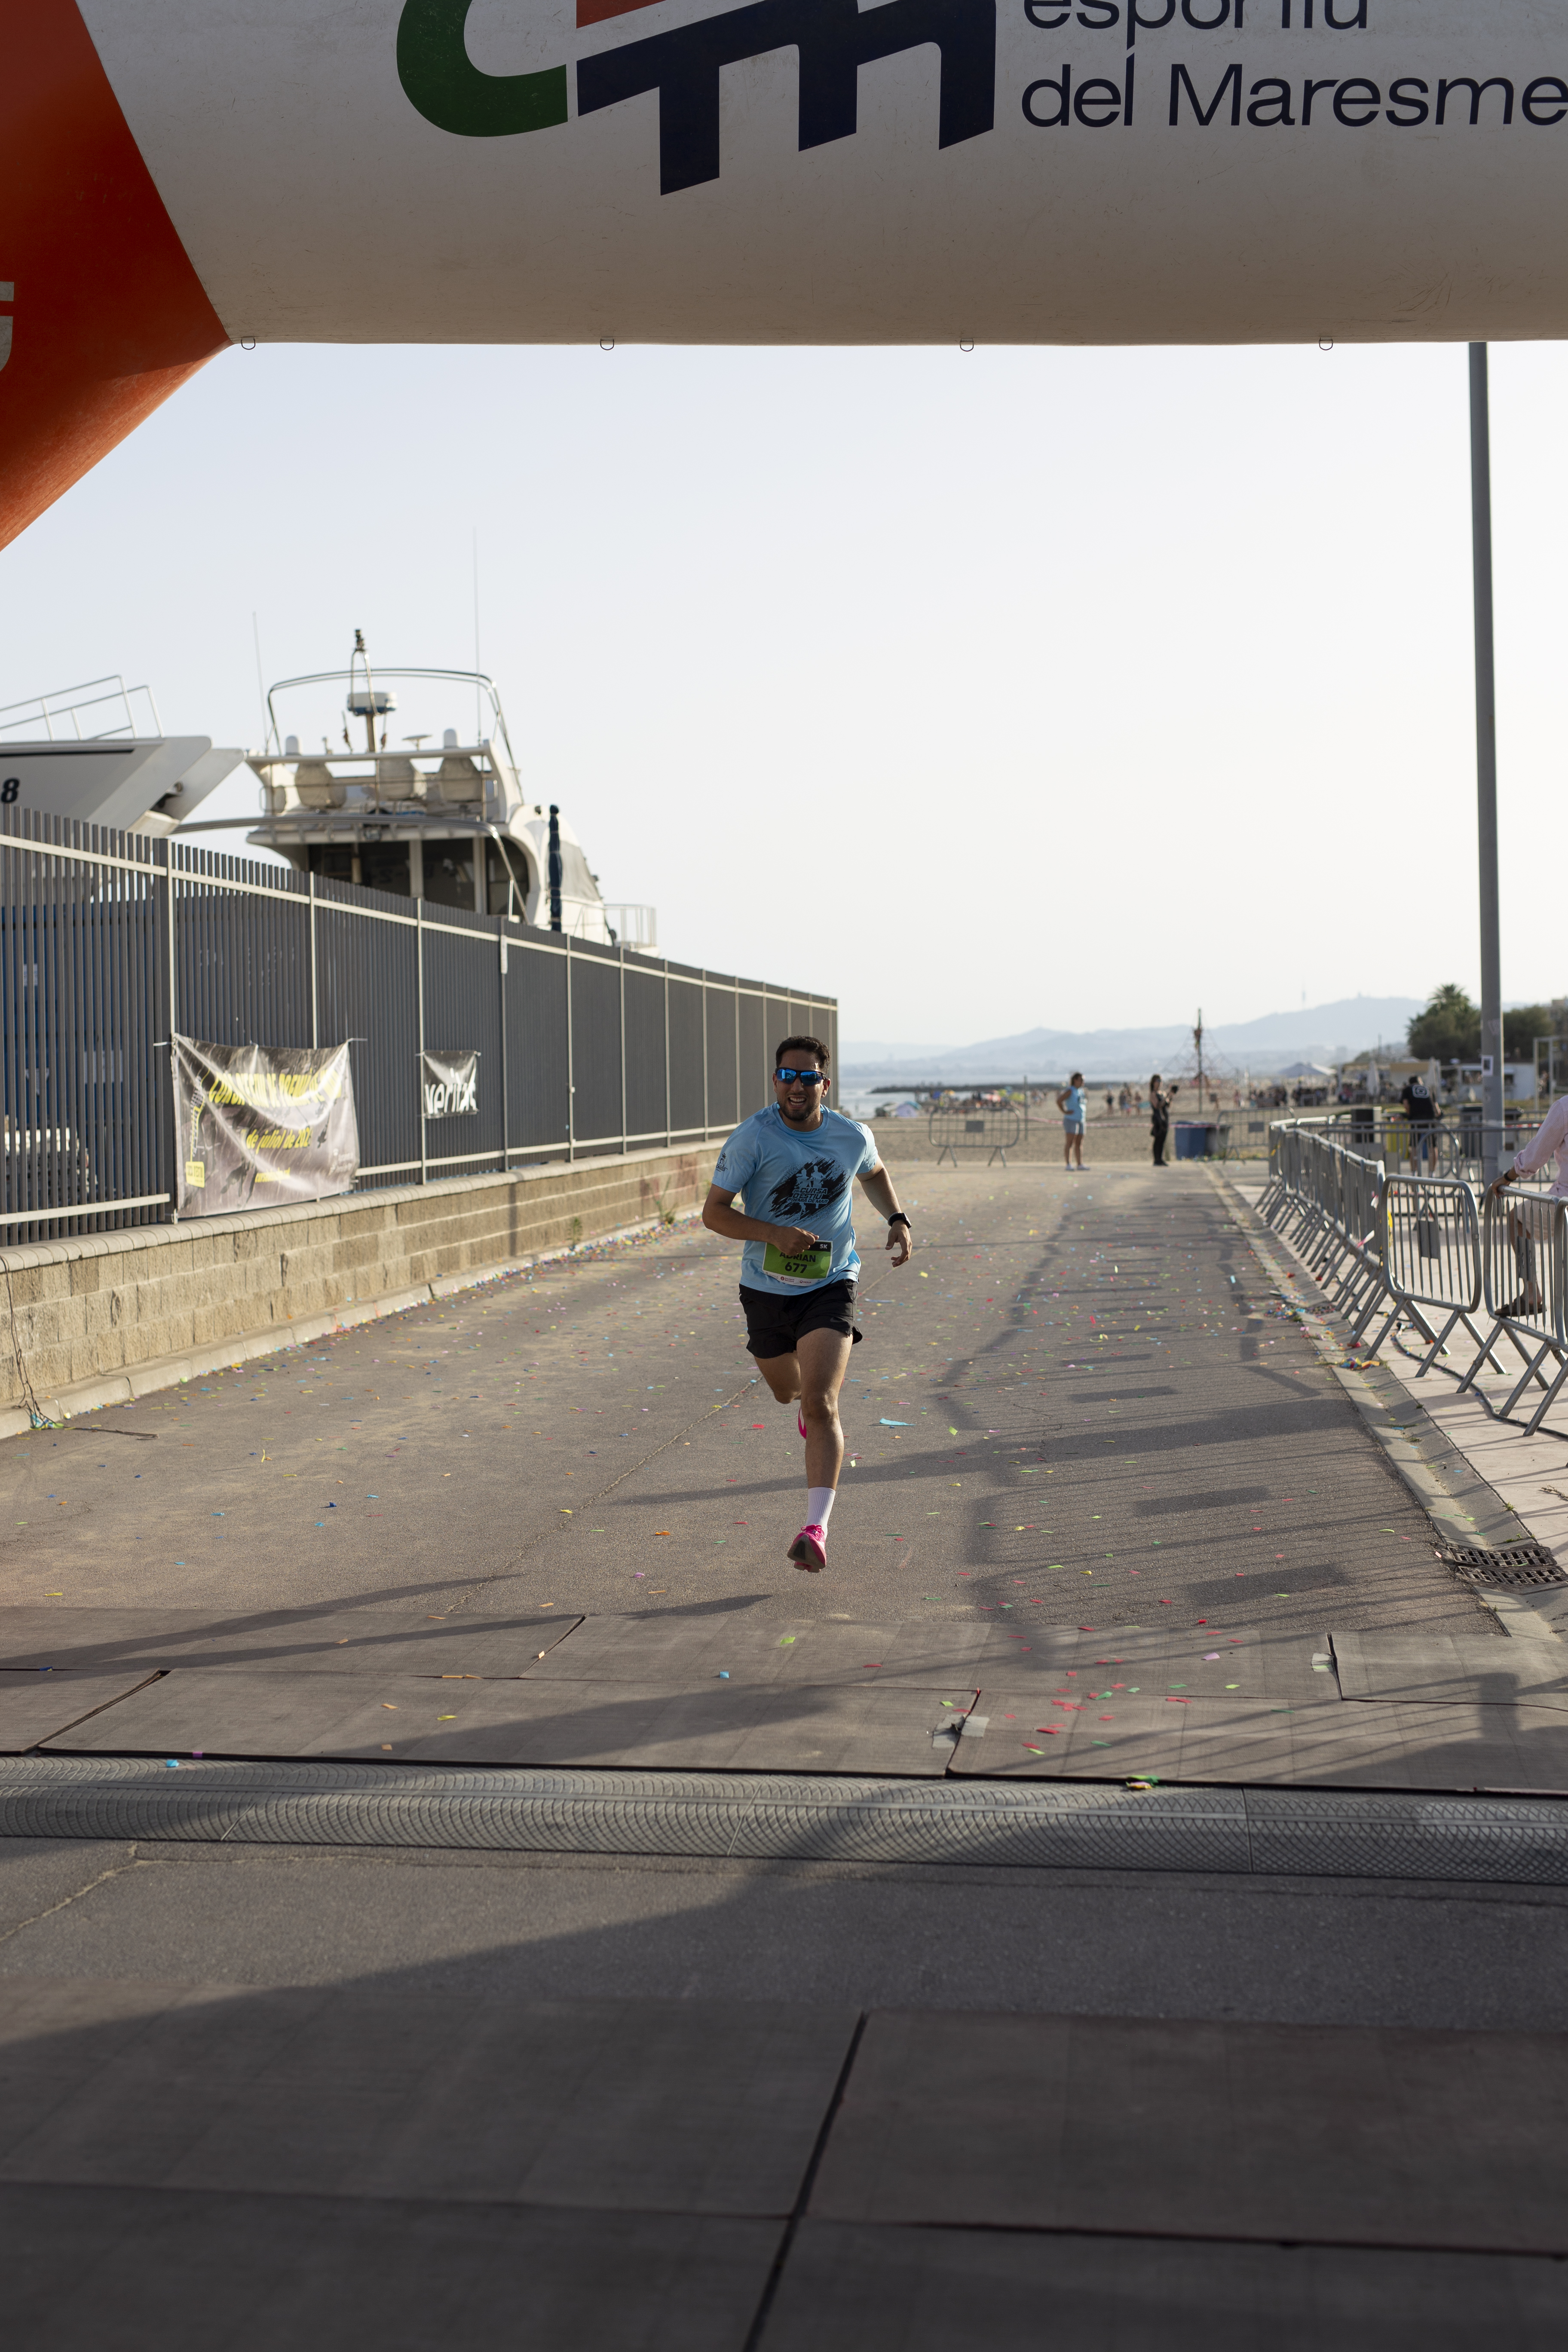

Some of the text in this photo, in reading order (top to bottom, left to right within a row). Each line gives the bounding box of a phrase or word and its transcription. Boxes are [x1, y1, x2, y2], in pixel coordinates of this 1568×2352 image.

[1022, 52, 1568, 127] del Maresme
[1, 778, 19, 803] 8
[246, 1129, 259, 1149] de
[256, 1129, 286, 1155] juliol
[283, 1129, 295, 1148] de
[779, 1252, 816, 1262] ADRIAN
[785, 1262, 808, 1274] 677
